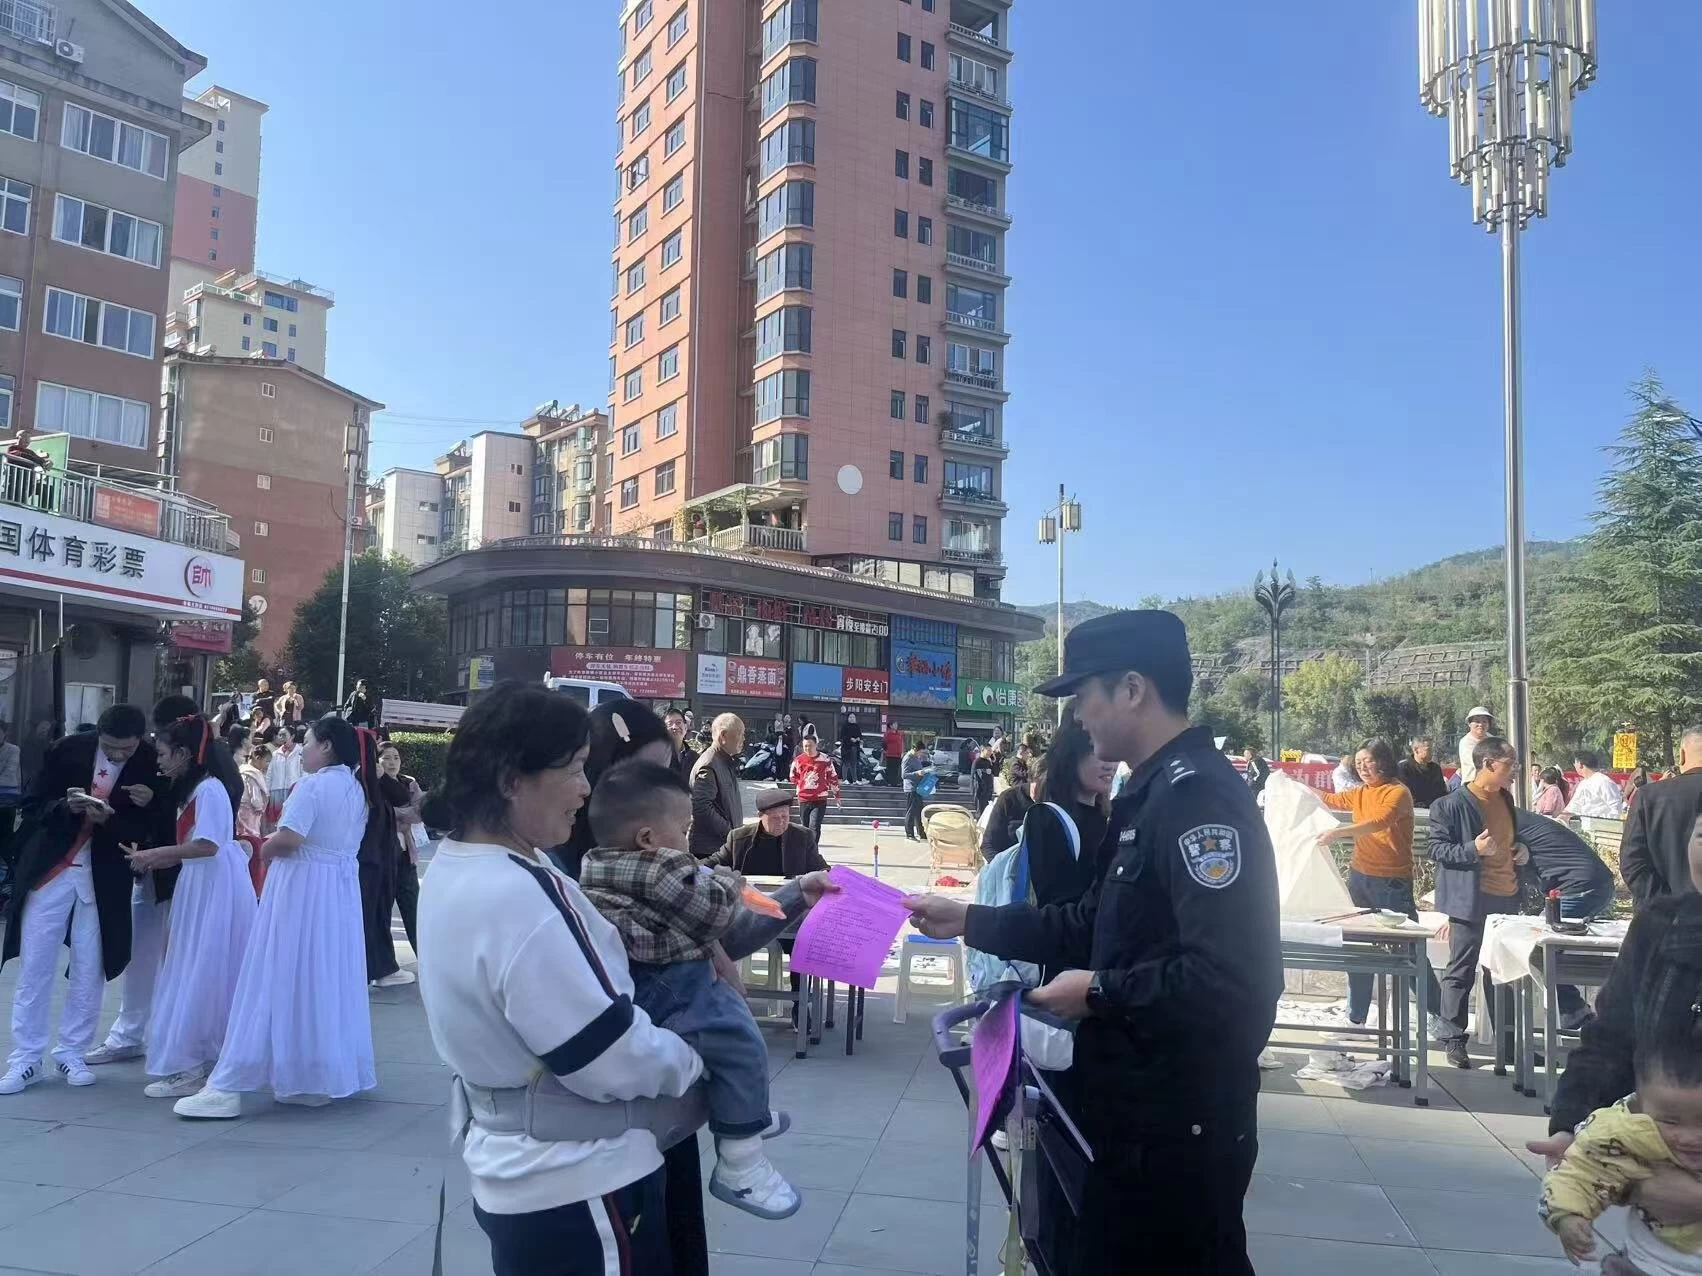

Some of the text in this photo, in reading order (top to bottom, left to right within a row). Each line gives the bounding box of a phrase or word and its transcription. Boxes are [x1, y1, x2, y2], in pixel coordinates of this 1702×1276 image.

[0, 520, 146, 578] 国体育彩票
[737, 665, 777, 686] 鼎香蒸面
[846, 677, 889, 694] 步阳安全门
